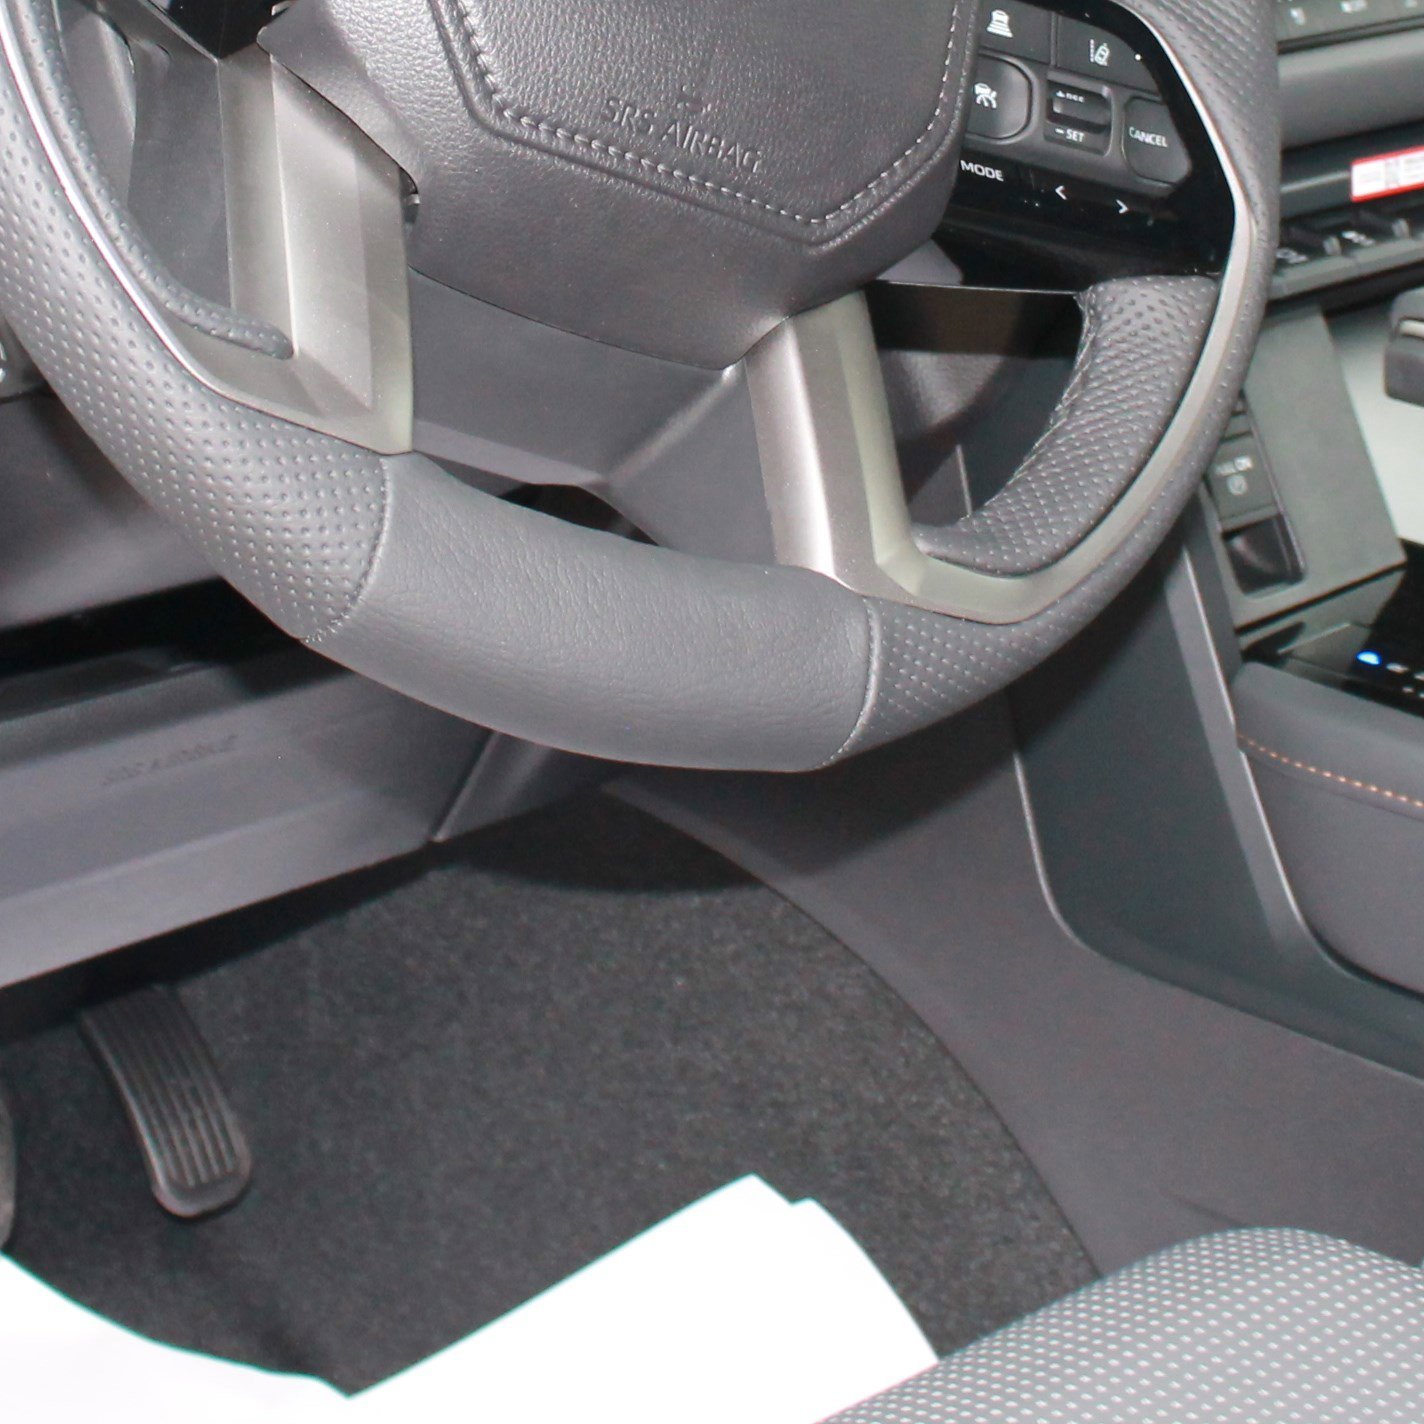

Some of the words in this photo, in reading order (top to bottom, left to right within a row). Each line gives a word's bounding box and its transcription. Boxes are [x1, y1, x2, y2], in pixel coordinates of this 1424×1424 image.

[606, 96, 657, 136] SRS
[661, 121, 764, 174] AIRBAG
[1065, 128, 1085, 143] SET
[1128, 126, 1168, 148] CANCEL
[960, 159, 1004, 181] MODE
